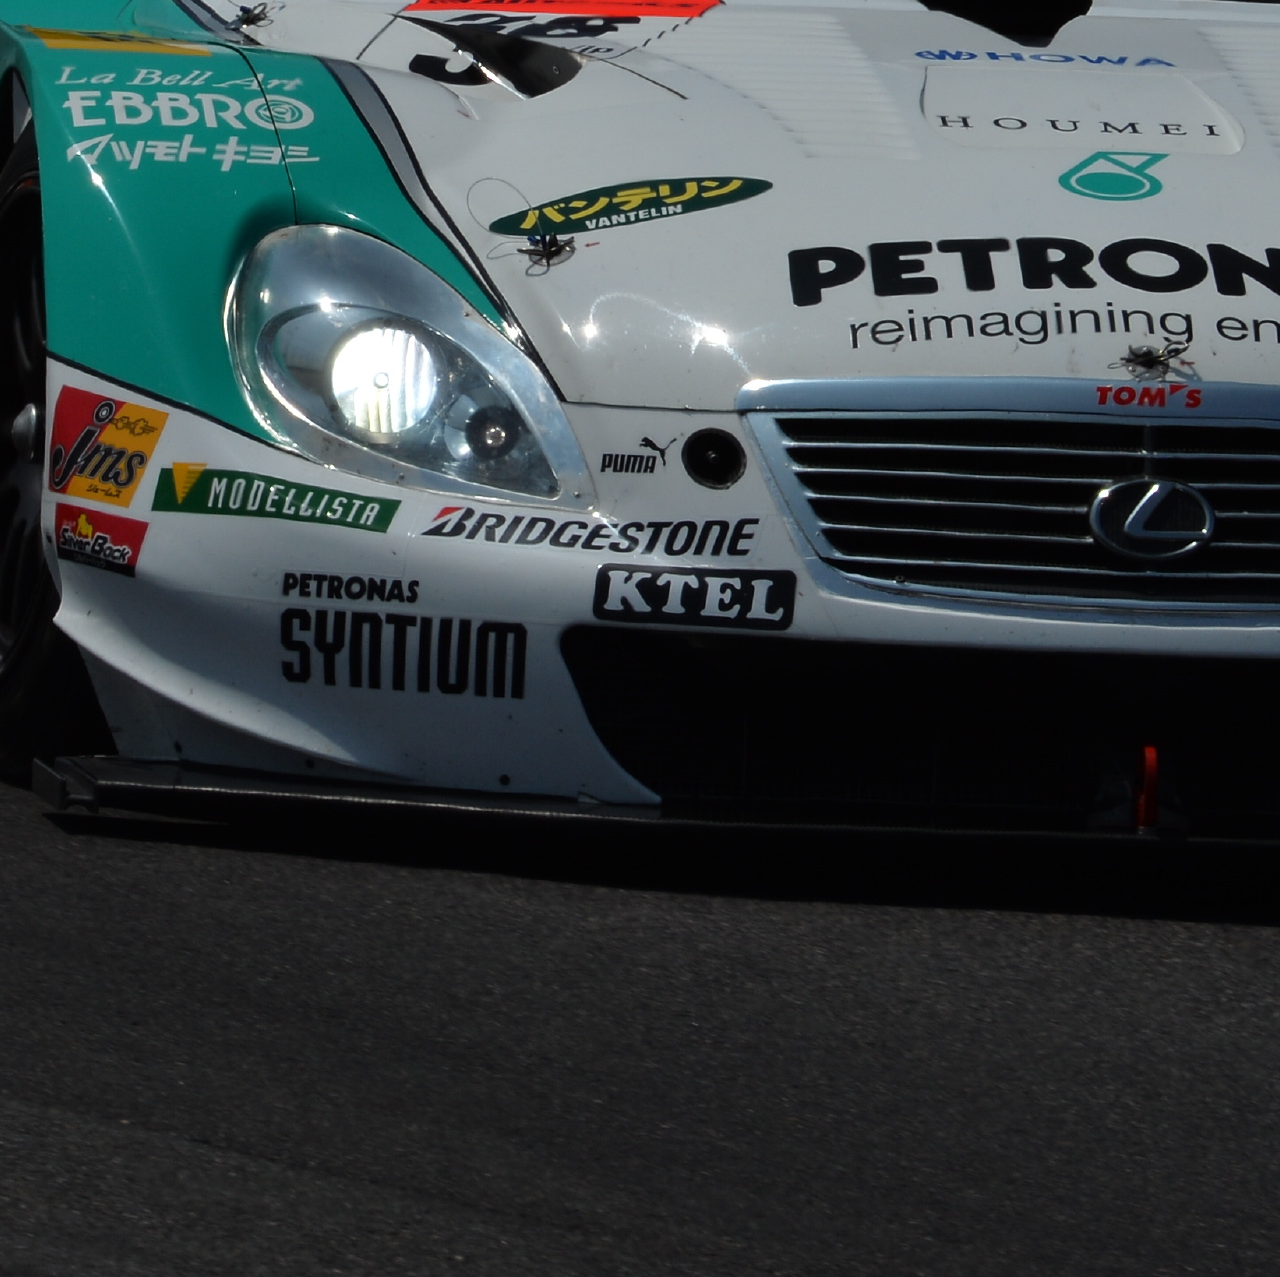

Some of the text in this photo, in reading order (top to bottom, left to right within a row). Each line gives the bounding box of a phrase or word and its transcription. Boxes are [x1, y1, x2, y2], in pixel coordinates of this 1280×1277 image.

[986, 52, 1177, 67] HOWA
[55, 65, 305, 91] La Bell Art
[62, 90, 315, 130] EBBRO
[936, 114, 1222, 137] HOUMEI
[520, 179, 745, 230] バンテリン
[584, 204, 684, 230] VANTELIN
[850, 302, 1194, 350] reimagining
[1095, 382, 1203, 410] TOM'S
[600, 452, 657, 475] PUMA
[207, 476, 381, 526] MODELLISTA
[420, 506, 761, 557] BRIDGESTONE
[282, 571, 421, 604] PETRONAS
[602, 569, 785, 623] KTEL
[280, 608, 528, 700] SYNTIUM
